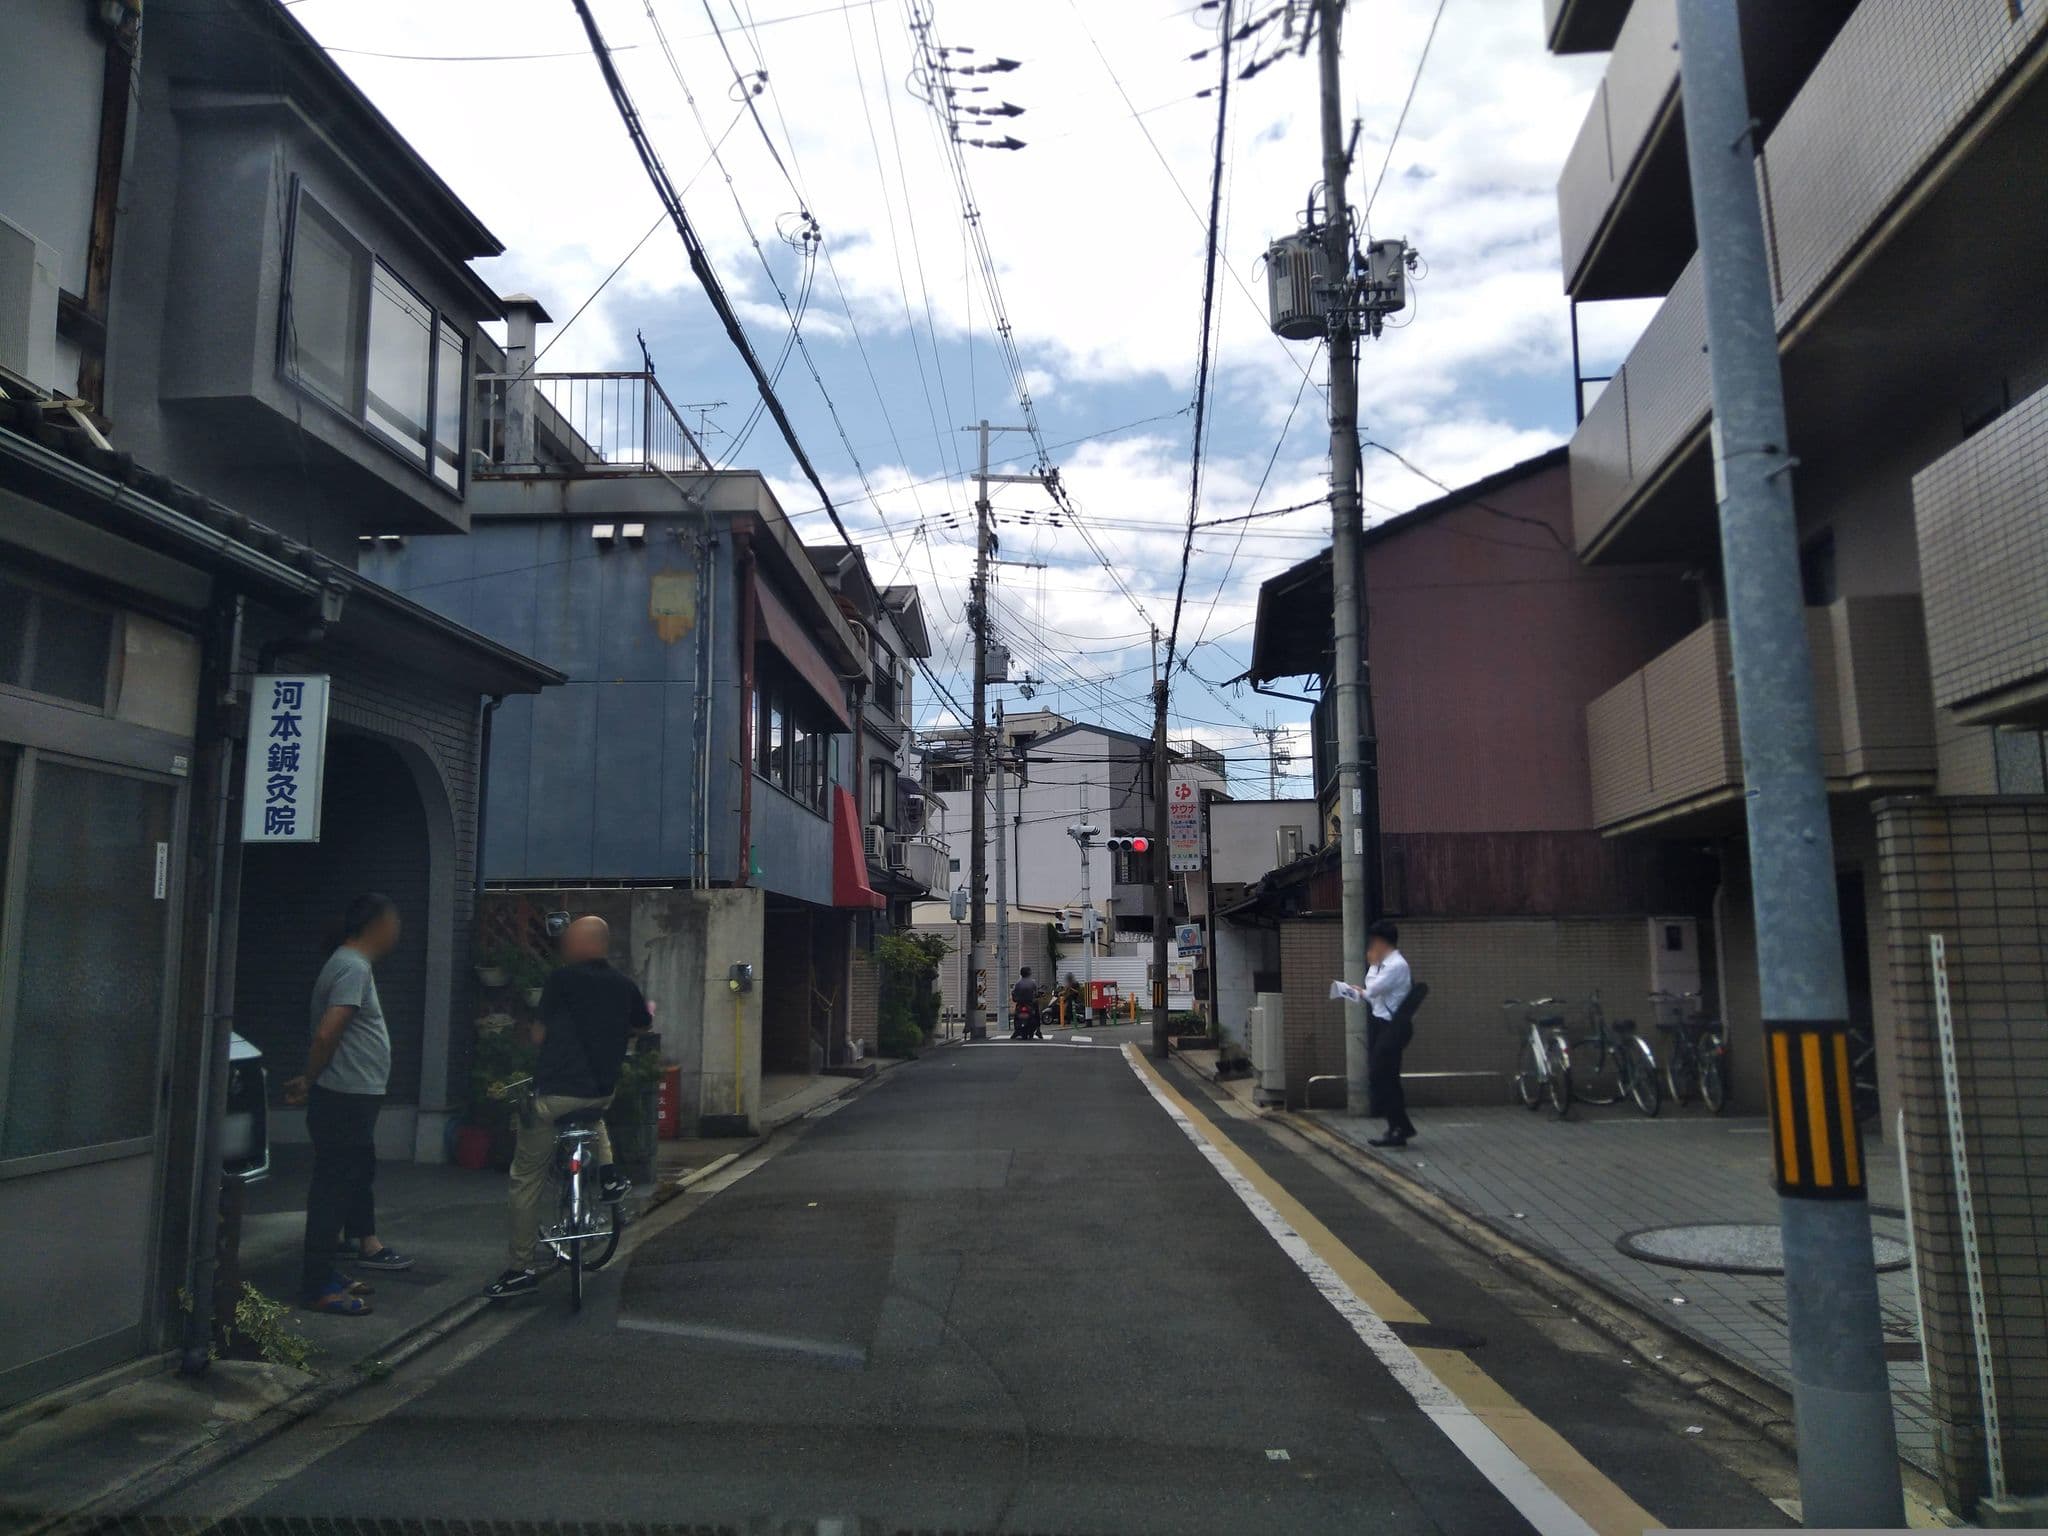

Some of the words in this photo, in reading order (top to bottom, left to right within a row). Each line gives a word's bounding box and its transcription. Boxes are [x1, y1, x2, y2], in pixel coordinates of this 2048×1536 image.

[264, 681, 305, 835] 河本鍼灸院
[1175, 783, 1191, 800] ゆ
[1170, 804, 1196, 814] サウナ
